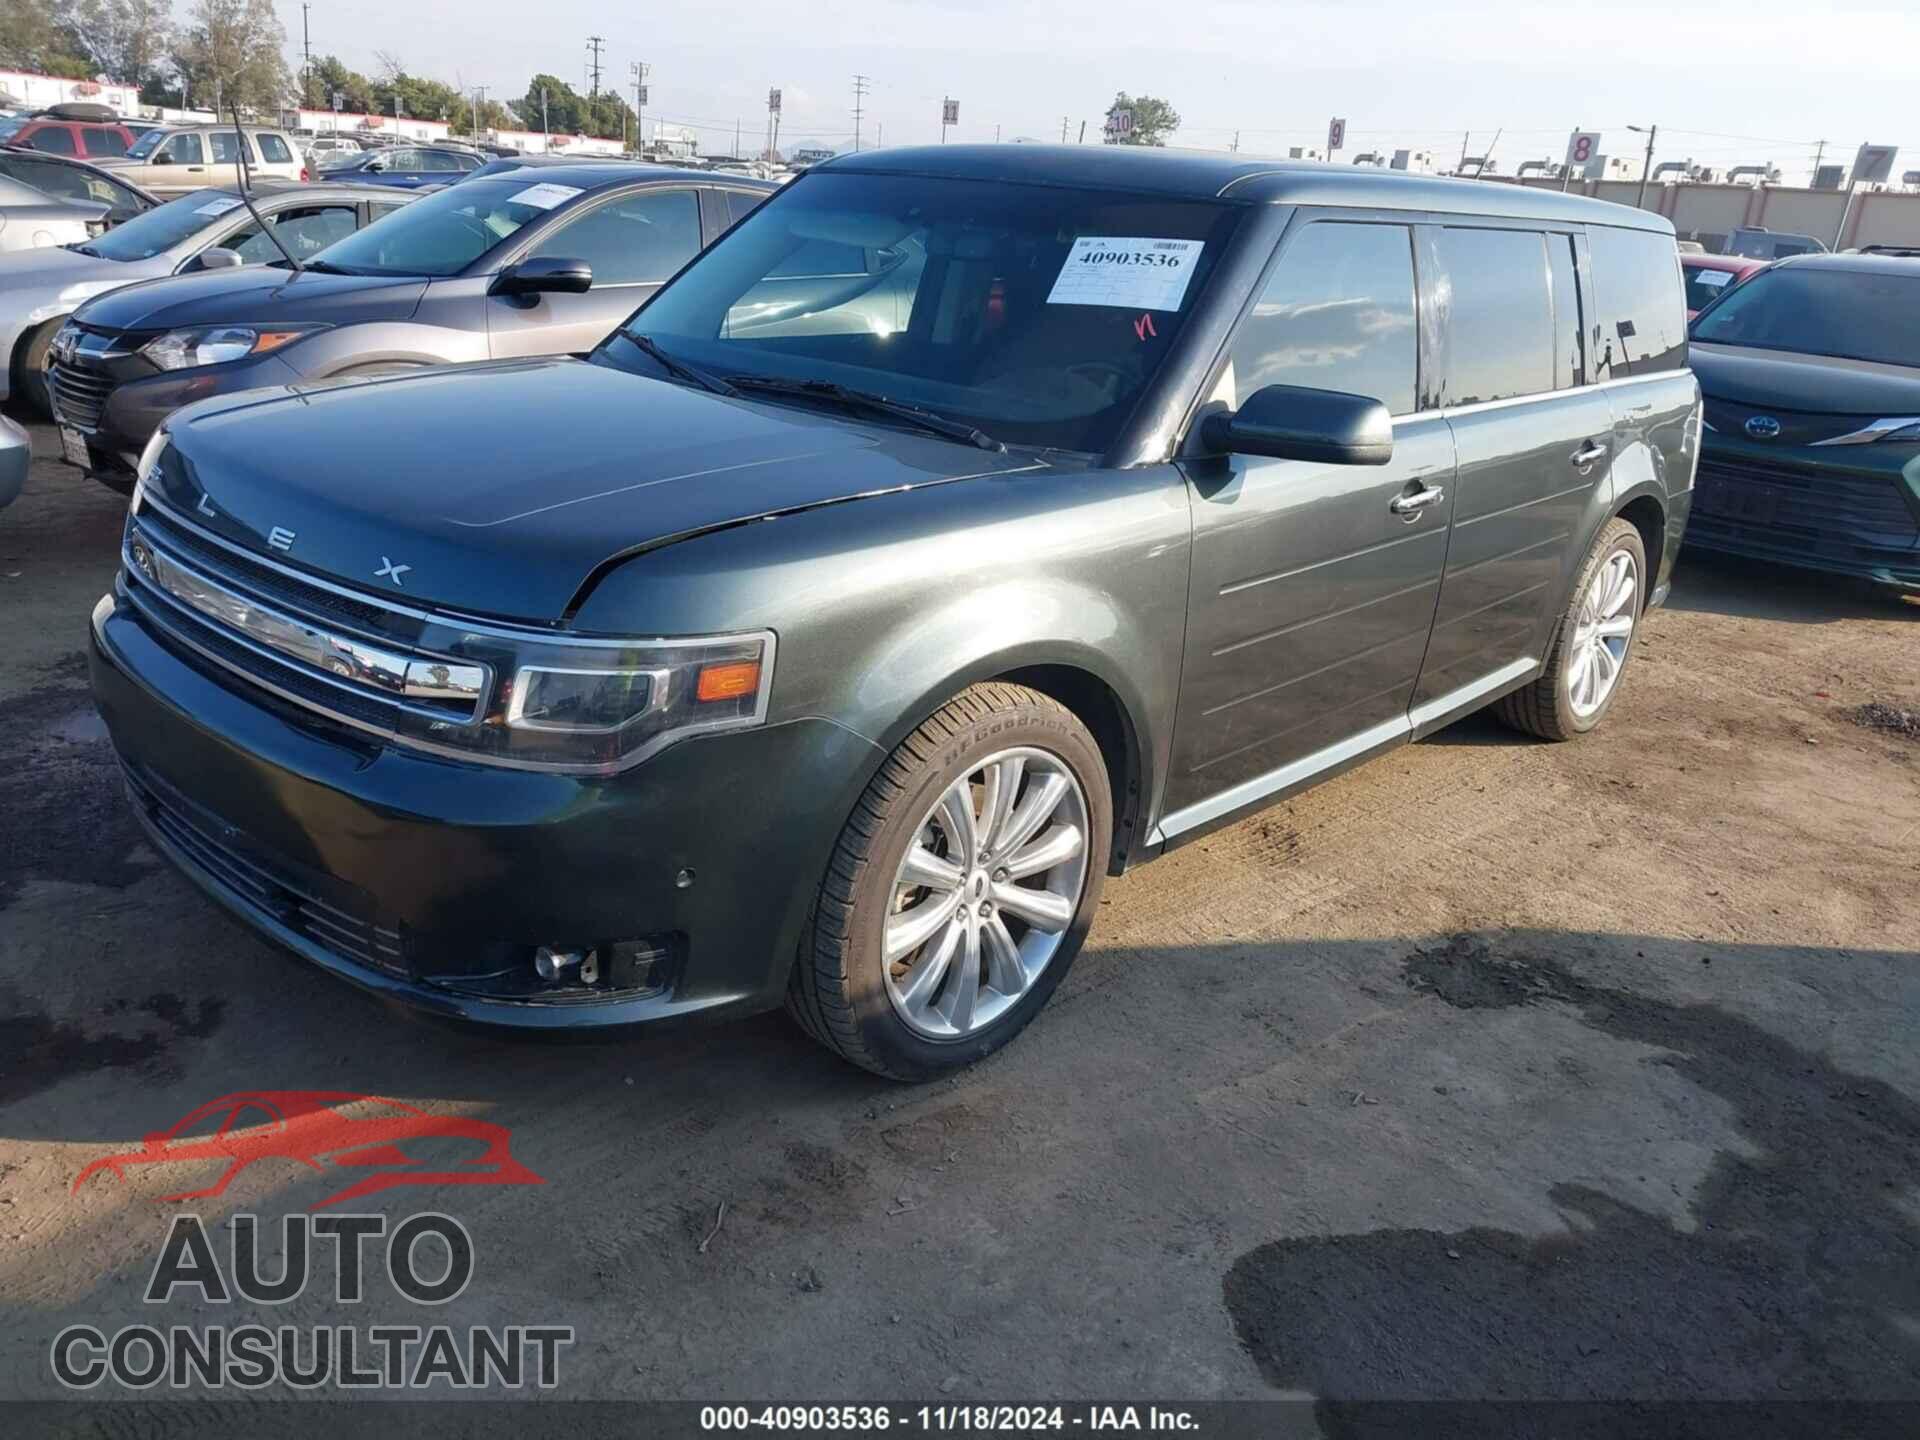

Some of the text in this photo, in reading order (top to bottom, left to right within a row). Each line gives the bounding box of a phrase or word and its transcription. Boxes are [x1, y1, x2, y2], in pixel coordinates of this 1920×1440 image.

[944, 104, 958, 120] 11
[1115, 114, 1130, 132] 10
[1332, 123, 1342, 146] 9
[1574, 136, 1592, 162] 8
[1864, 150, 1889, 178] 7
[1079, 251, 1180, 268] 40903536
